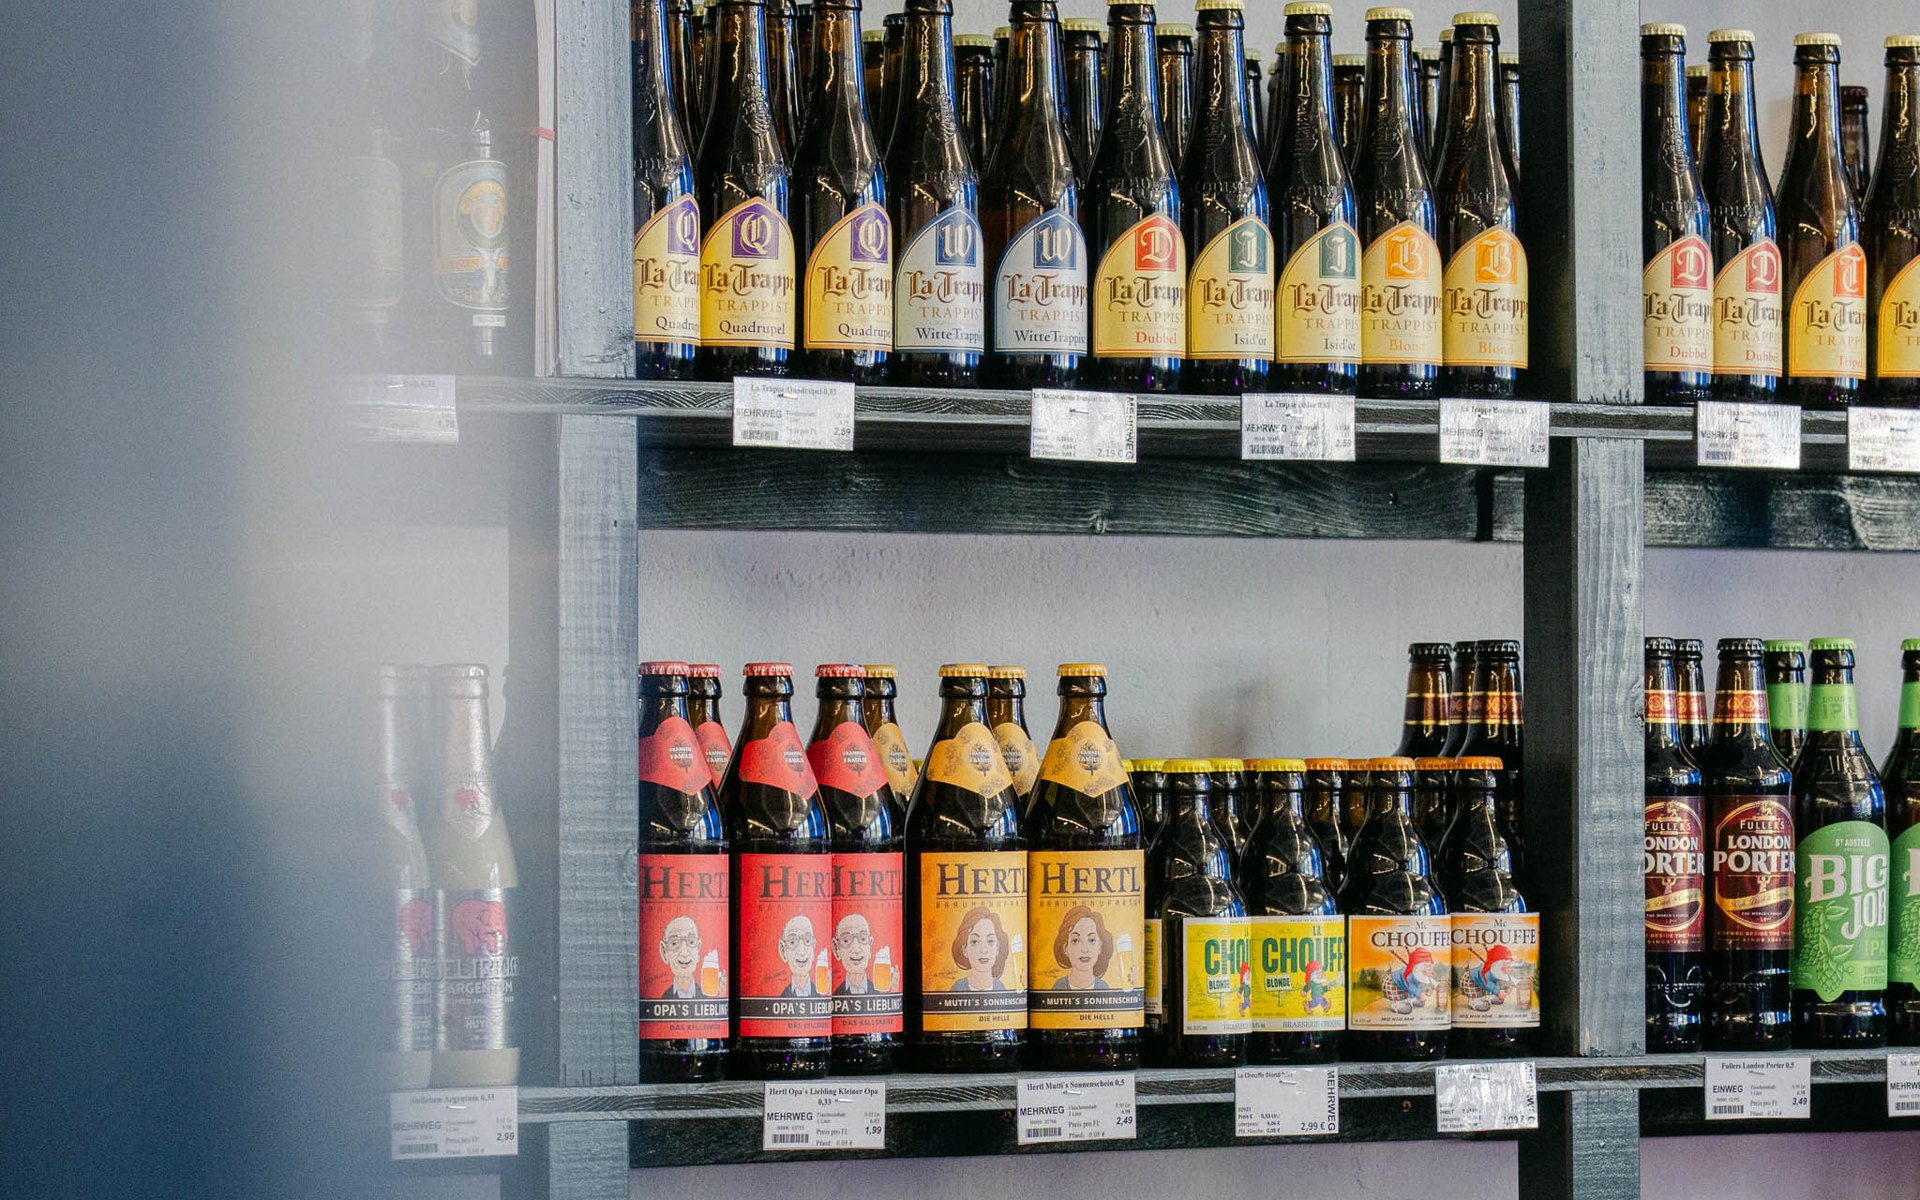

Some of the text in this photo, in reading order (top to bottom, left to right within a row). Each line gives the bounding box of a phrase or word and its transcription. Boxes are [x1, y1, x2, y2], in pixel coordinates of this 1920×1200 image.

[676, 209, 697, 251] Q
[740, 210, 772, 256] Q
[858, 218, 886, 259] Q
[941, 223, 973, 259] W
[1040, 227, 1071, 261] W
[1141, 227, 1173, 263] D
[1391, 235, 1423, 274] B
[1481, 239, 1513, 278] B
[1676, 246, 1706, 281] D
[1751, 251, 1777, 286] D
[634, 258, 664, 295] La
[702, 262, 729, 299] La
[817, 266, 848, 300] La
[904, 270, 935, 306] La
[1003, 273, 1033, 310] La
[717, 300, 790, 314] TRAPPIST
[1104, 276, 1134, 312] La
[1198, 278, 1228, 314] La
[1287, 283, 1317, 318] La
[1361, 284, 1383, 314] La
[1444, 287, 1473, 321] La
[1643, 293, 1669, 326] La
[719, 319, 786, 335] Quadrupel
[1018, 309, 1085, 322] TRAPPIST
[1716, 296, 1743, 331] La
[1801, 300, 1829, 334] La
[1889, 301, 1918, 335] La
[1136, 331, 1177, 345] Dubbel
[1389, 339, 1427, 351] Blond
[1478, 342, 1513, 354] Blond
[1668, 346, 1707, 359] Dubbel
[1727, 834, 1791, 850] LONDON
[1040, 862, 1140, 894] HERTL
[1713, 850, 1796, 874] PORTER
[1804, 853, 1888, 903] BIG
[1451, 928, 1537, 945] CHOUFFE
[1262, 938, 1345, 974] CHOUFF
[1266, 977, 1291, 988] BLONDE
[810, 1088, 837, 1096] Liebling
[864, 1088, 878, 1096] Opa
[1027, 1083, 1044, 1091] Hertl
[1070, 1080, 1113, 1089] Sonnenschein
[1114, 1079, 1125, 1087] 0,5
[1327, 1070, 1336, 1131] MEHRWEG
[1713, 1085, 1743, 1093] EINWEG
[1792, 1097, 1808, 1106] 3,49
[766, 1112, 813, 1121] MEHRWEG
[818, 1098, 832, 1106] 0,33
[1020, 1105, 1064, 1116] MEHRWEG
[496, 1132, 515, 1141] 2,99
[865, 1126, 882, 1135] 1,99
[1116, 1116, 1133, 1126] 2,49
[1300, 1121, 1326, 1132] 2,99 €
